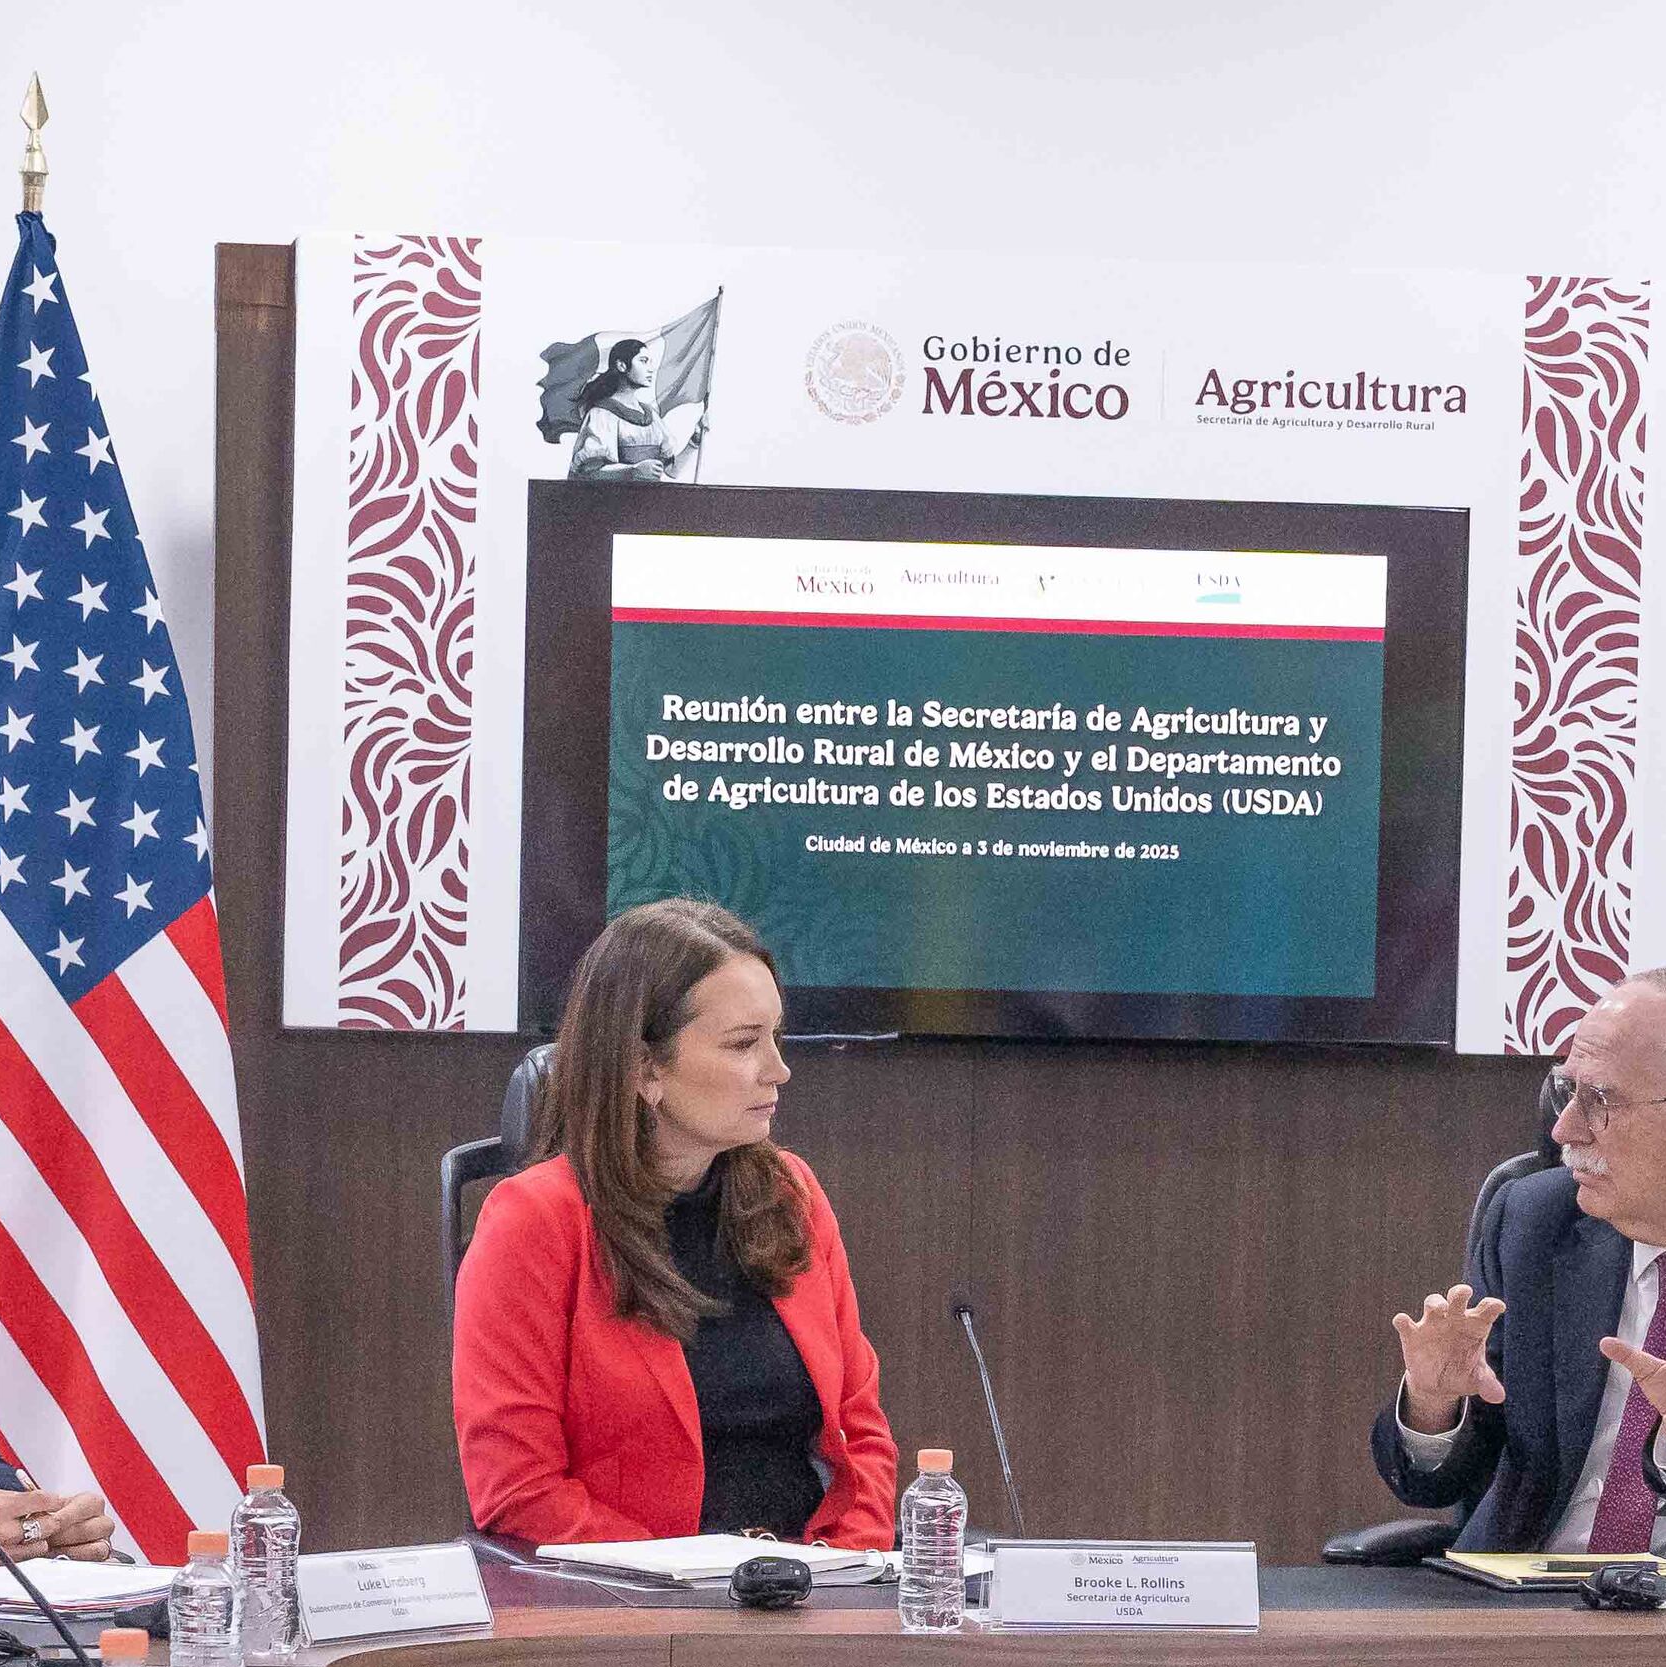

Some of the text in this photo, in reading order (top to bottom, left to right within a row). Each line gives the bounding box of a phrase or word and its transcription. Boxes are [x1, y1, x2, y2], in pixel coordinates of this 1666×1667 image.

[924, 336, 1131, 367] Gobierno de
[922, 367, 1128, 420] México
[1195, 369, 1467, 414] Agricultura
[1256, 417, 1268, 425] de
[1272, 417, 1333, 428] Agricultura
[1347, 420, 1402, 429] Desarrollo
[1406, 421, 1434, 430] Rural
[901, 569, 1000, 585] Agricultura
[663, 695, 1327, 743] Reunión entre la Secretaría de Agricultura y
[647, 735, 1341, 779] Desarrollo Rural de México y el Departamento
[663, 774, 1322, 815] de Agricultura de los Estados Unidos (USDA)
[806, 836, 1179, 859] Ciudad de México a 3 de noviembre de 2025
[1088, 1556, 1124, 1565] México
[357, 1579, 382, 1593] Luke
[1074, 1576, 1185, 1589] Brooke L. Rollins
[1119, 1593, 1132, 1603] de
[1134, 1593, 1190, 1605] Agricultura
[1115, 1607, 1144, 1616] USDA
